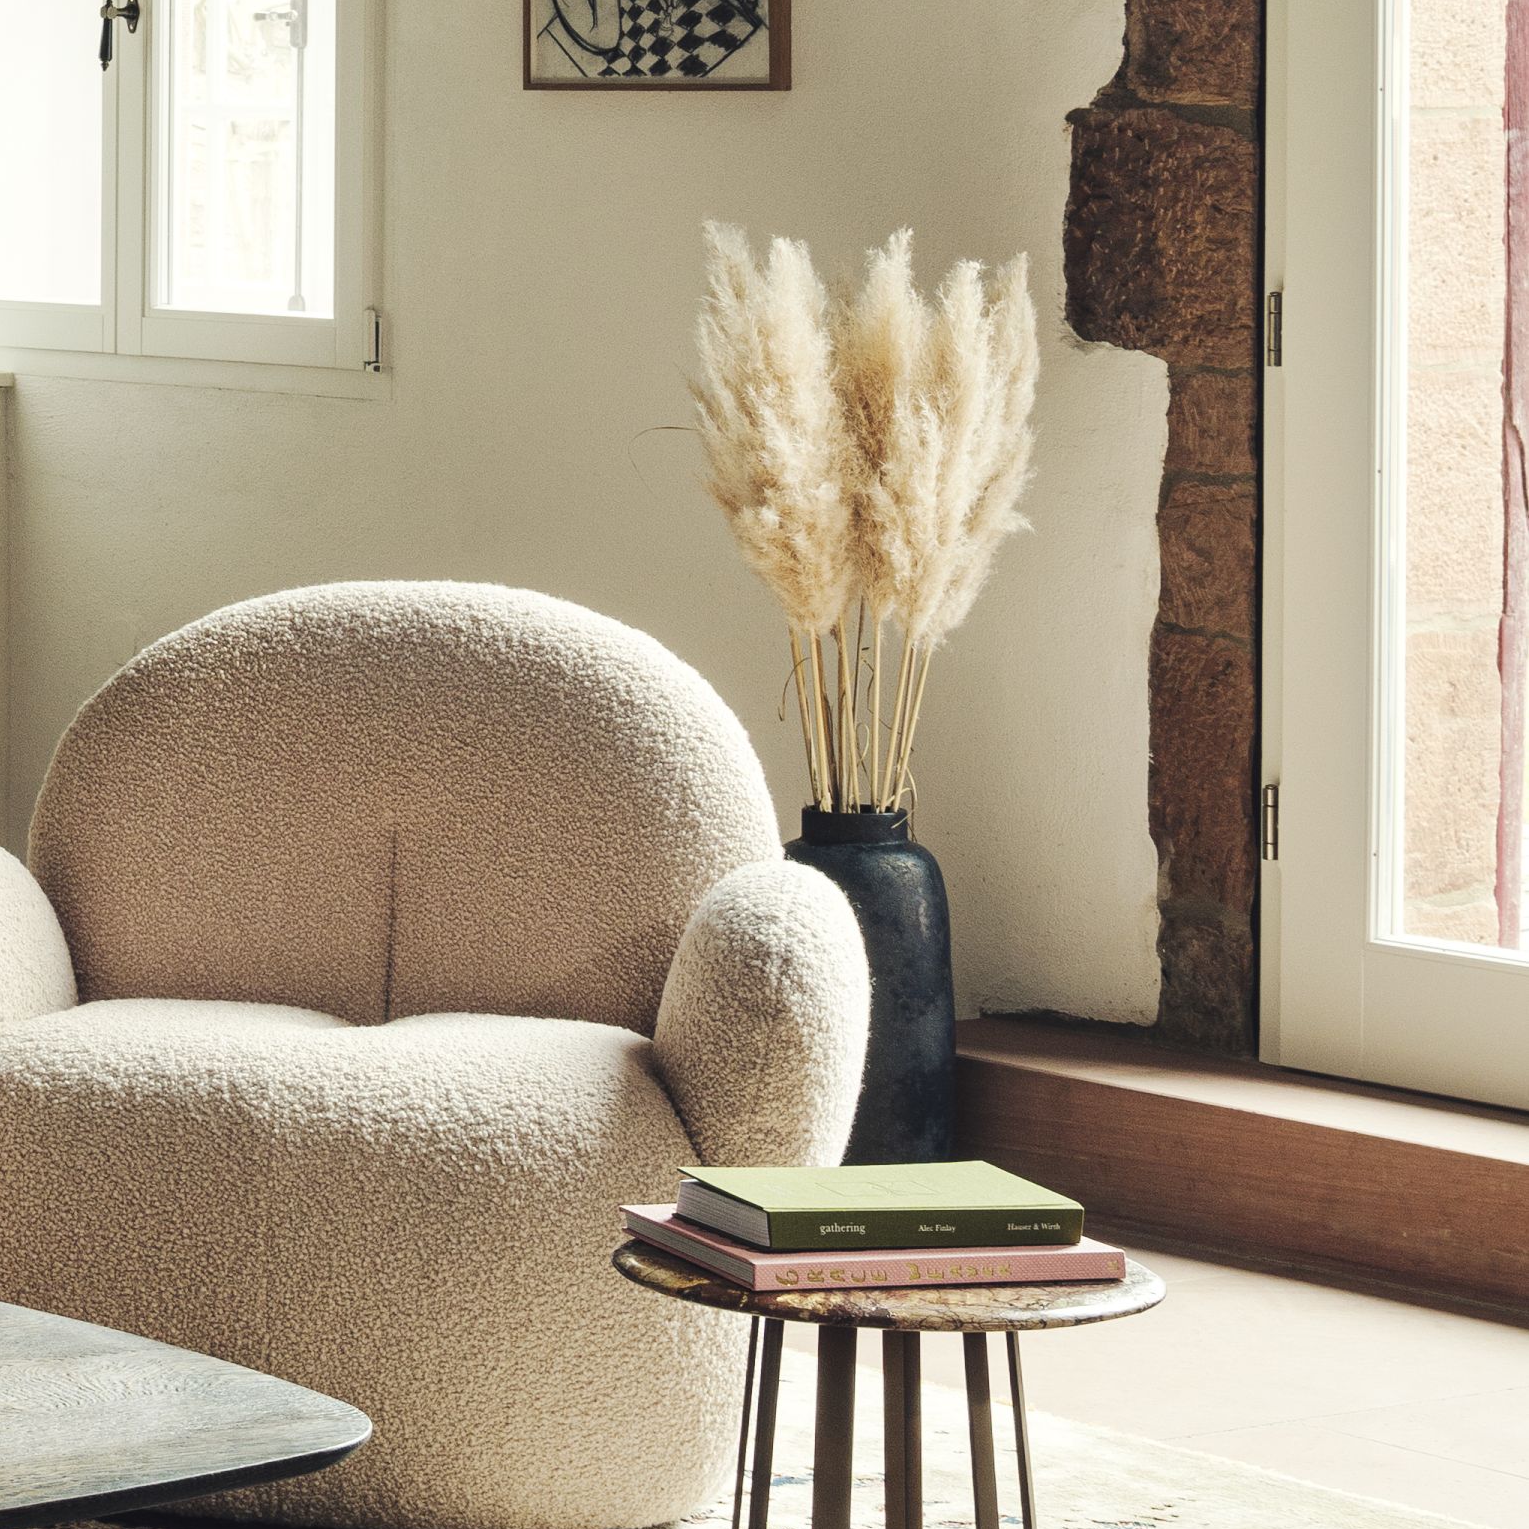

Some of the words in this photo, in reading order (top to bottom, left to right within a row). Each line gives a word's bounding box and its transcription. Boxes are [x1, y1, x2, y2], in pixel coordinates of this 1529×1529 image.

[819, 1222, 866, 1235] gathering
[918, 1223, 933, 1233] Alec
[935, 1223, 956, 1234] Finlay
[1007, 1222, 1032, 1231] Hauser
[1034, 1222, 1040, 1231] &
[1042, 1222, 1061, 1231] Wirth
